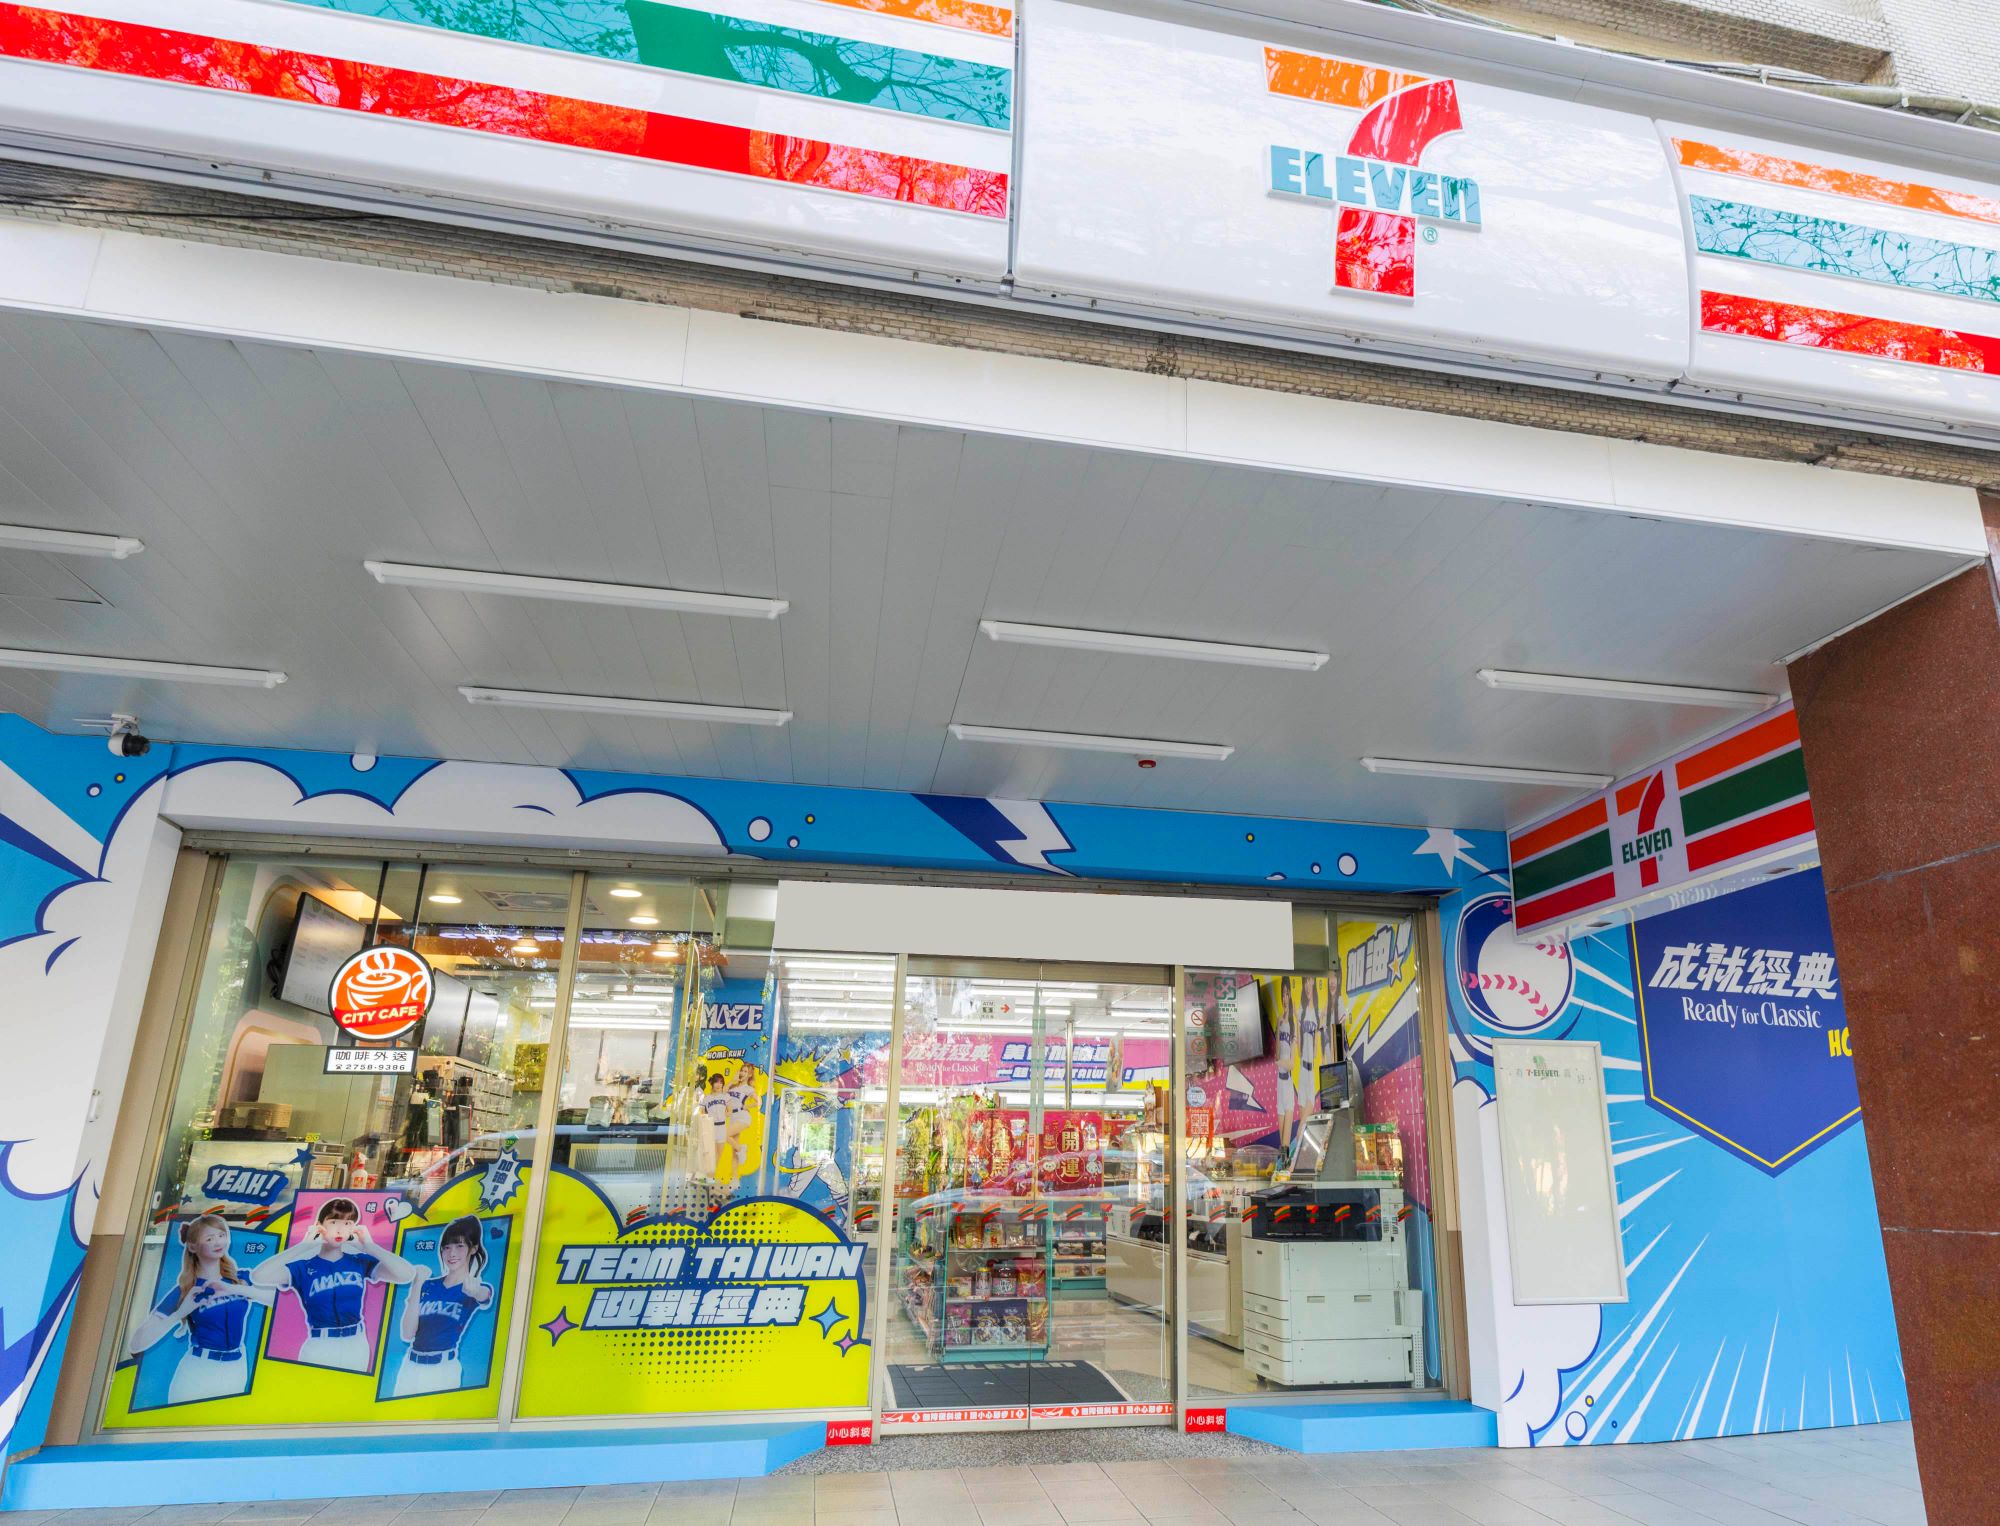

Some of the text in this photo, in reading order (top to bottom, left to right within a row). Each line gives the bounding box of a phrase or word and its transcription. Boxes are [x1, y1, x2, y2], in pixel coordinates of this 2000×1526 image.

[1648, 942, 1839, 1000] 成就經典
[341, 1005, 418, 1025] CITY CAFE
[1682, 996, 1823, 1029] Ready for Classic
[335, 1051, 408, 1062] 咖啡外送
[707, 1050, 727, 1060] HOME
[951, 1062, 980, 1074] Classic
[1060, 1129, 1081, 1178] 開運
[206, 1168, 280, 1198] YEAH!
[490, 1158, 514, 1196] 加油！
[245, 1243, 266, 1254] 短今
[415, 1240, 435, 1251] 衣宸
[559, 1244, 865, 1281] TEAM TAIWAN
[308, 1271, 365, 1297] AMAZE
[1186, 1415, 1225, 1426] 小心斜坡
[828, 1426, 871, 1439] 小心斜坡
